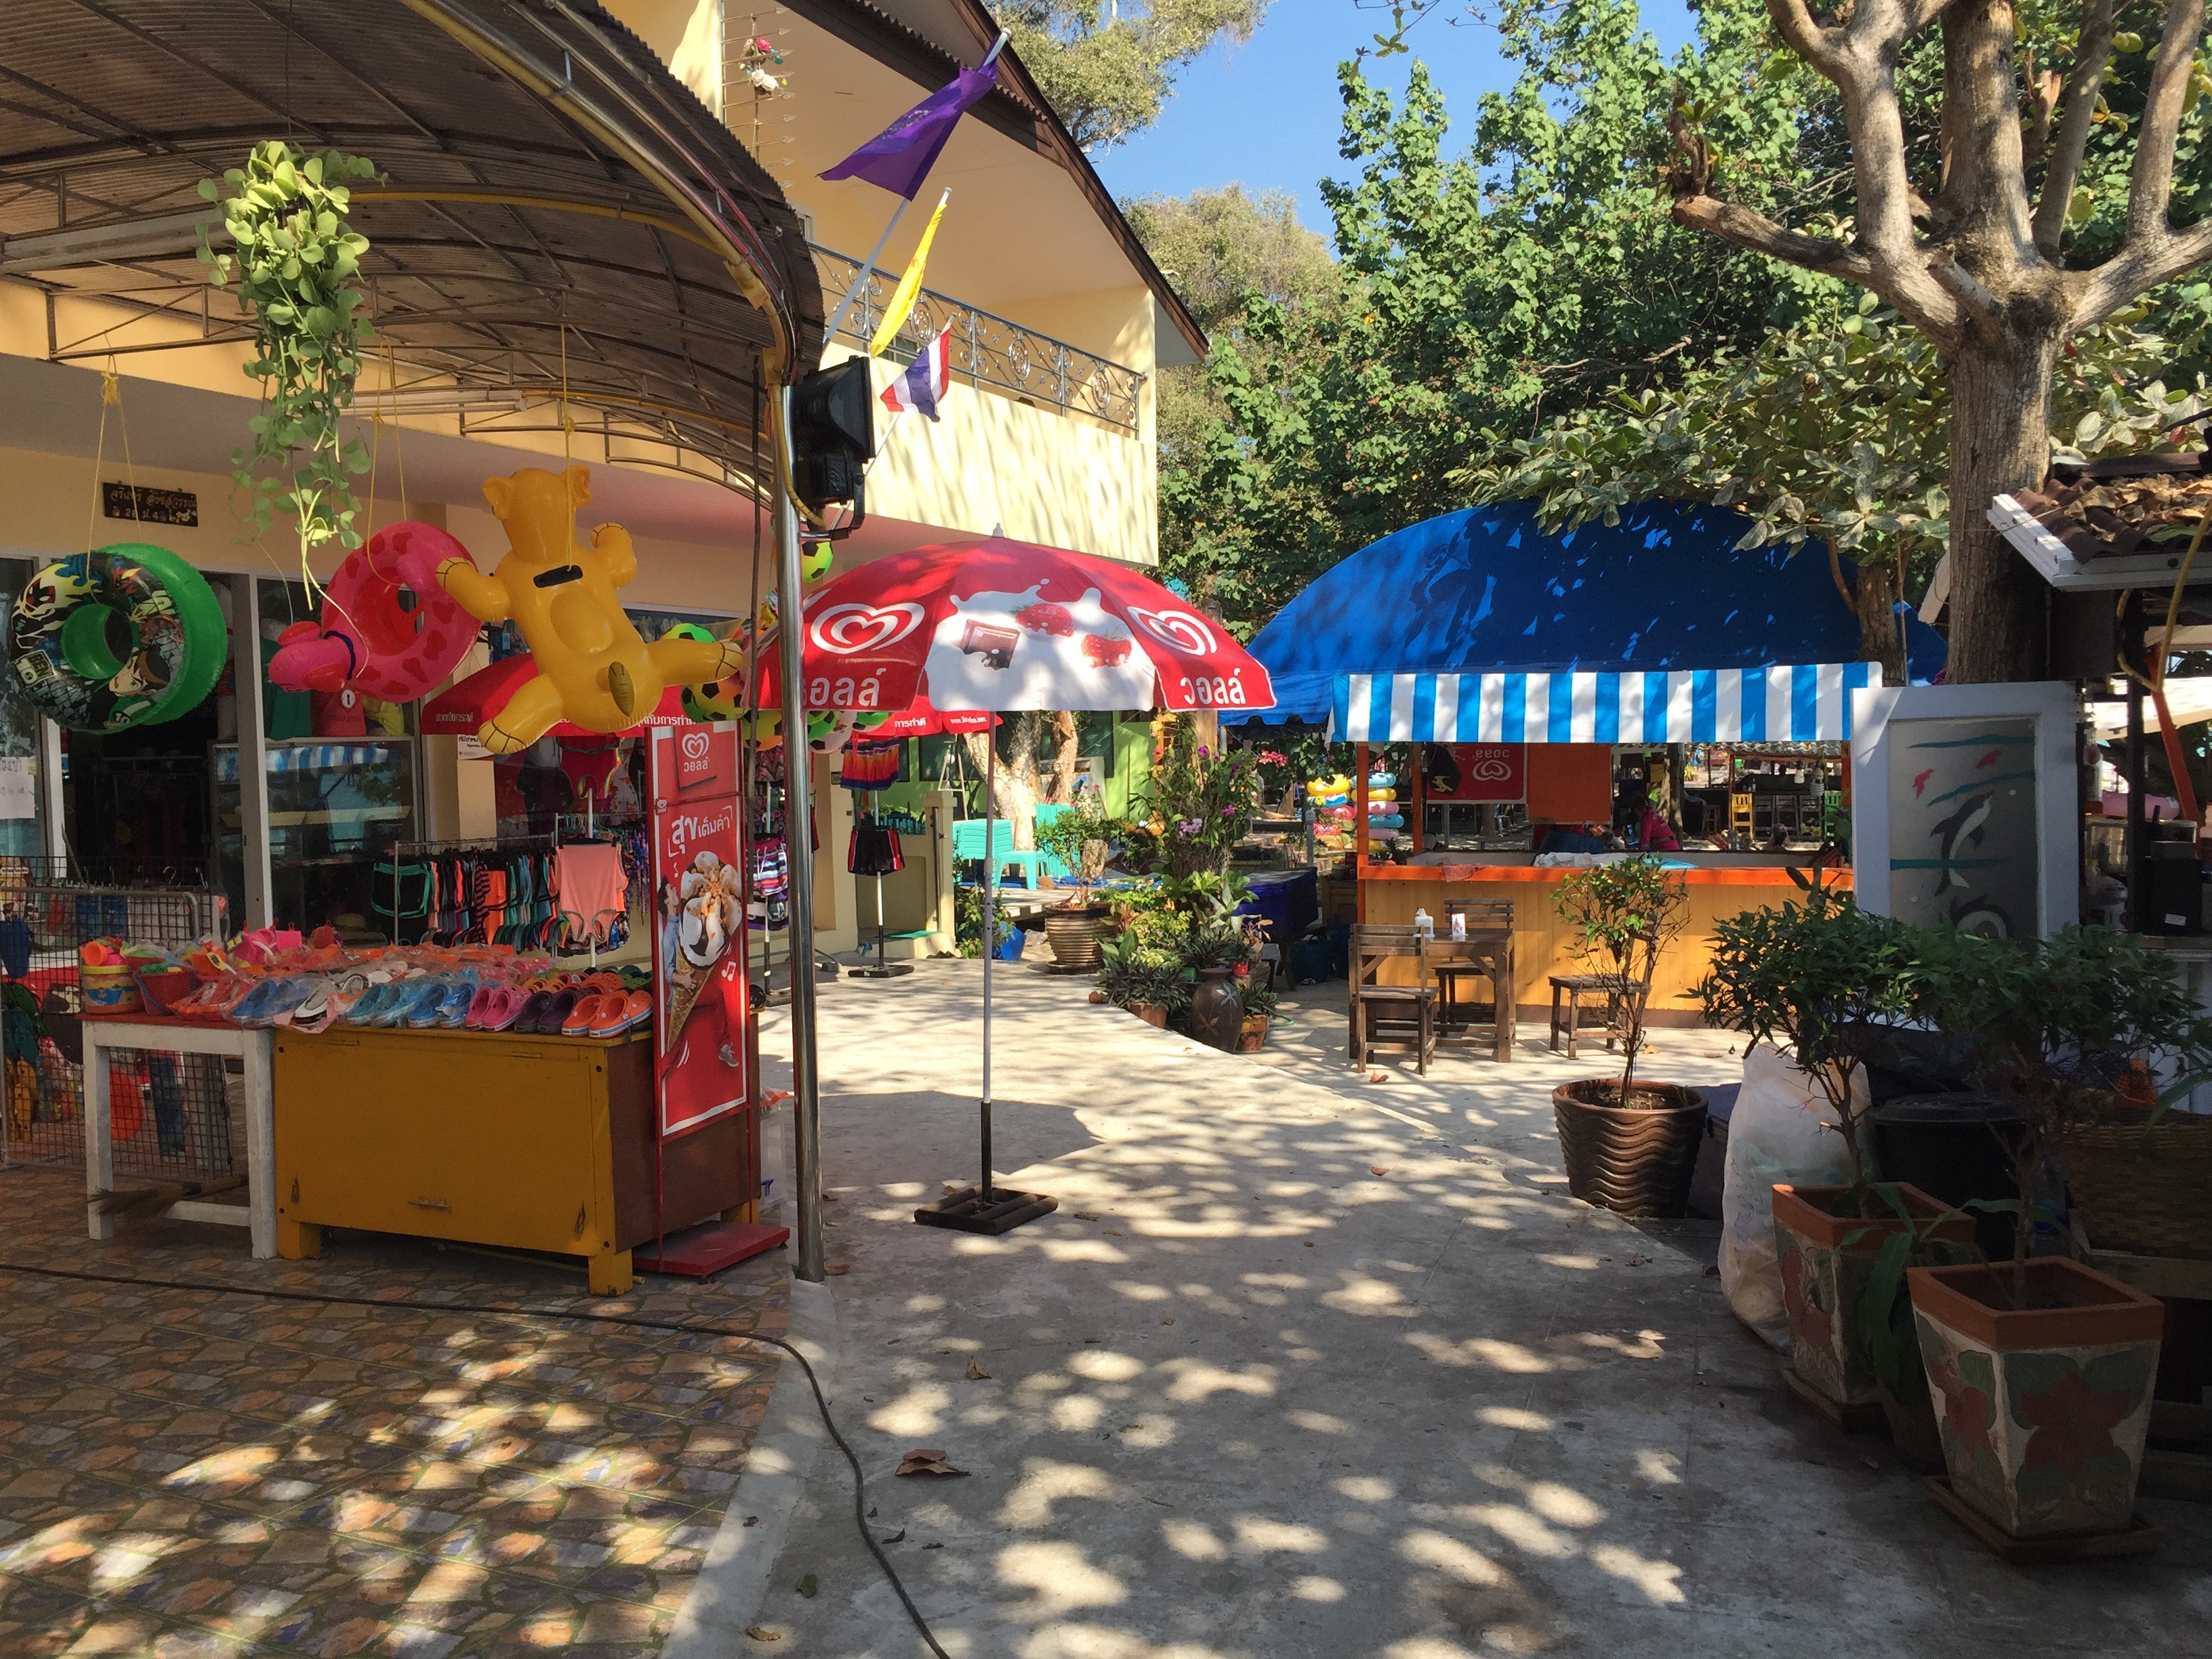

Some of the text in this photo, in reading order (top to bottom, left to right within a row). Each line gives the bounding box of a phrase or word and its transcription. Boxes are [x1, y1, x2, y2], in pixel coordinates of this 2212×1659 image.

[27, 653, 49, 678] BEN
[802, 668, 886, 706] อลล์
[1180, 668, 1246, 705] วอลล์
[683, 756, 709, 773] วอลล์
[1475, 749, 1510, 760] วอลล์
